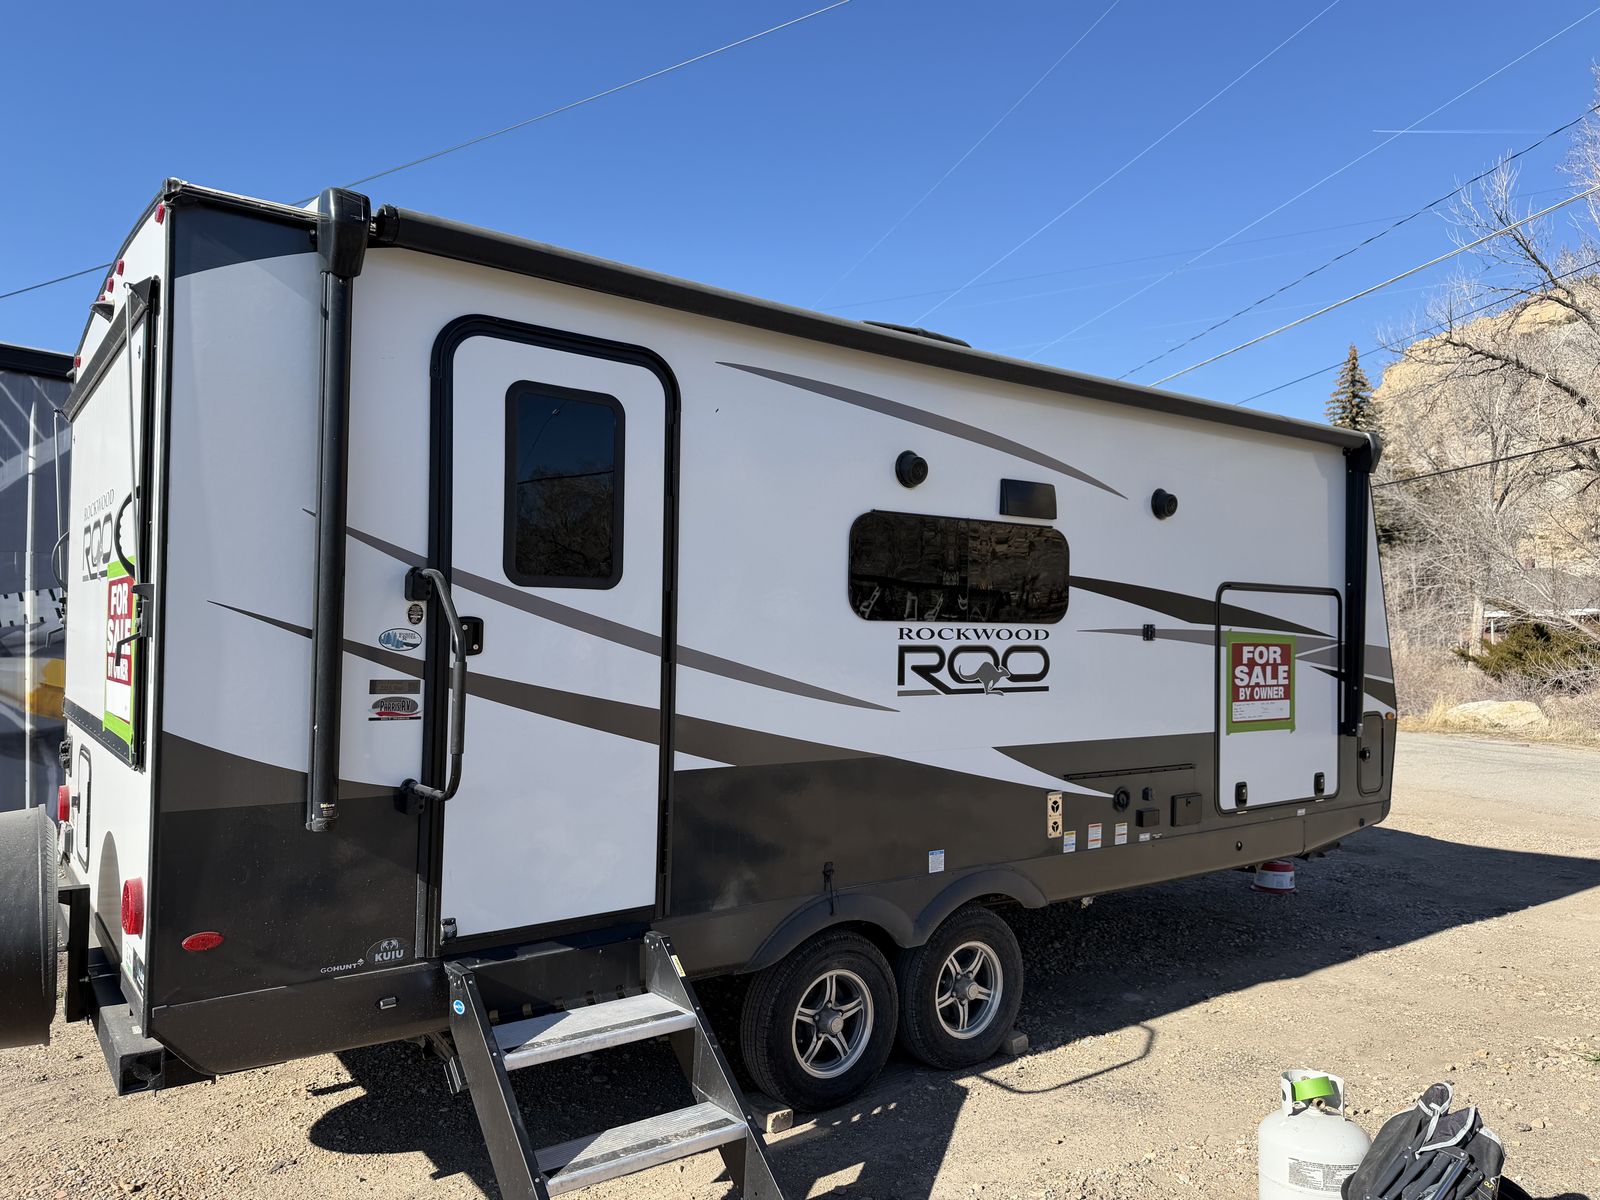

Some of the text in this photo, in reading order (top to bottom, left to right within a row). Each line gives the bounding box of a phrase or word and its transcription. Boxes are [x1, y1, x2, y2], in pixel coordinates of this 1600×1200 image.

[110, 582, 128, 616] FOR
[898, 627, 1050, 641] ROCKWOOD
[1242, 645, 1282, 664] FOR
[897, 644, 1050, 695] ROO
[1234, 665, 1289, 686] SALE
[1239, 686, 1284, 700] BY OWNER
[374, 949, 404, 962] KUIU
[320, 963, 357, 974] GOHUNT
